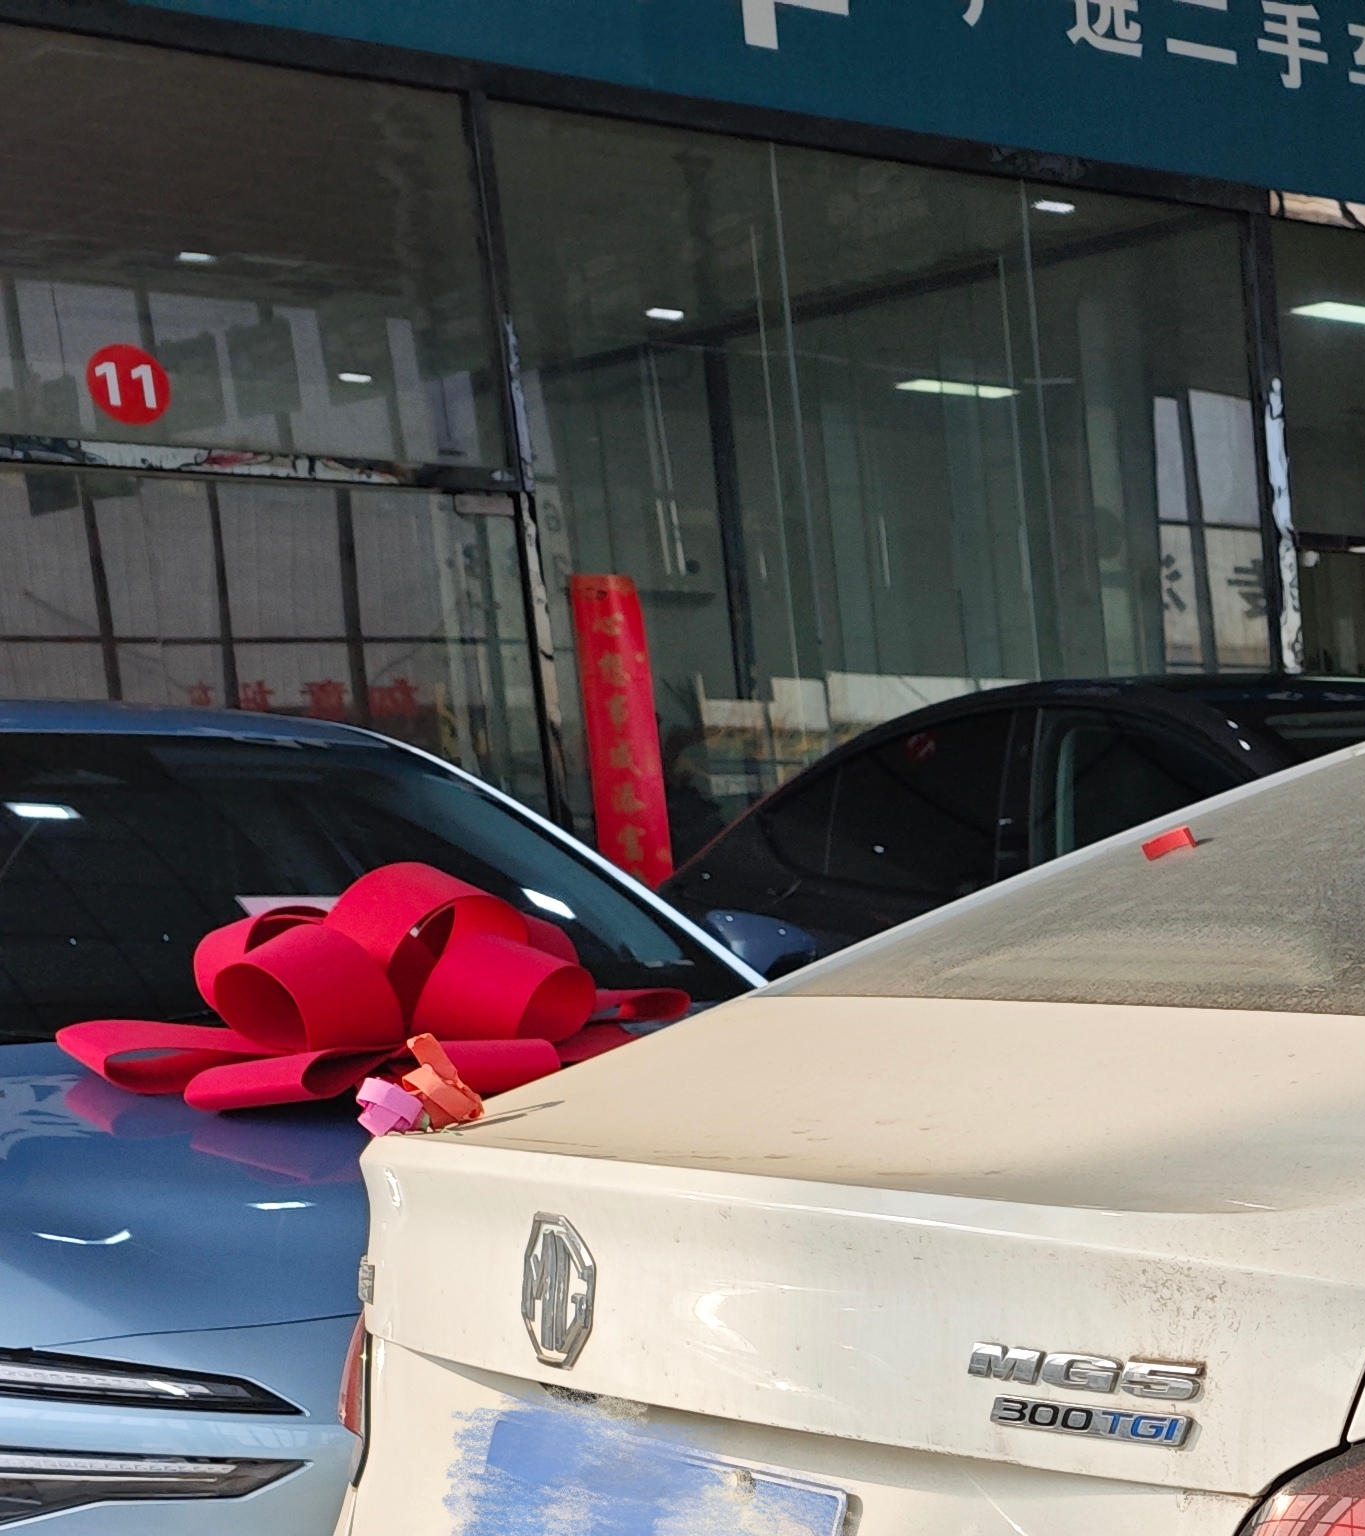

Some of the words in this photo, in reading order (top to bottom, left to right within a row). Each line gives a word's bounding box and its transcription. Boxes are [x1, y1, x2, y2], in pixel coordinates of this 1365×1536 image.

[94, 361, 159, 409] 11
[522, 1224, 595, 1357] MG
[967, 1340, 1207, 1403] MG5
